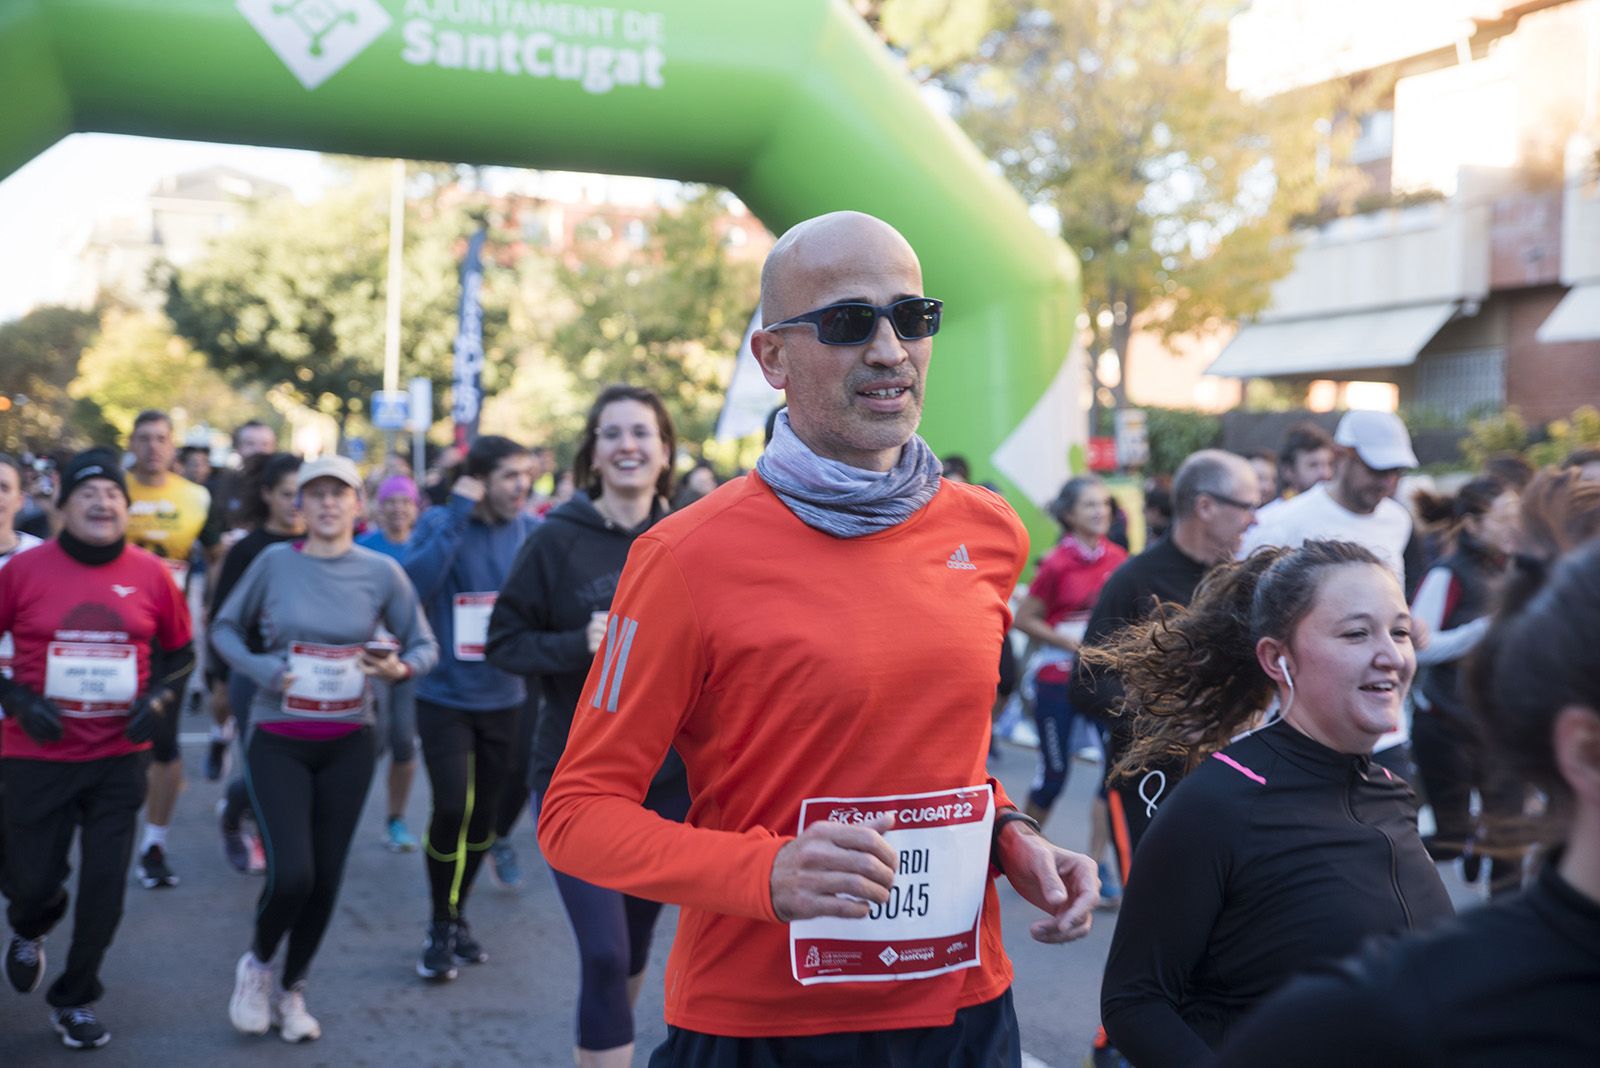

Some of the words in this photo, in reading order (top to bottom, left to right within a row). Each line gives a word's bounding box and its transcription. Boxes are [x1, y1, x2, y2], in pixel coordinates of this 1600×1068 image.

[624, 10, 664, 43] DE
[401, 18, 666, 93] SantCugat
[898, 804, 954, 824] CUGAT
[953, 802, 973, 818] 22
[899, 848, 929, 875] RDI
